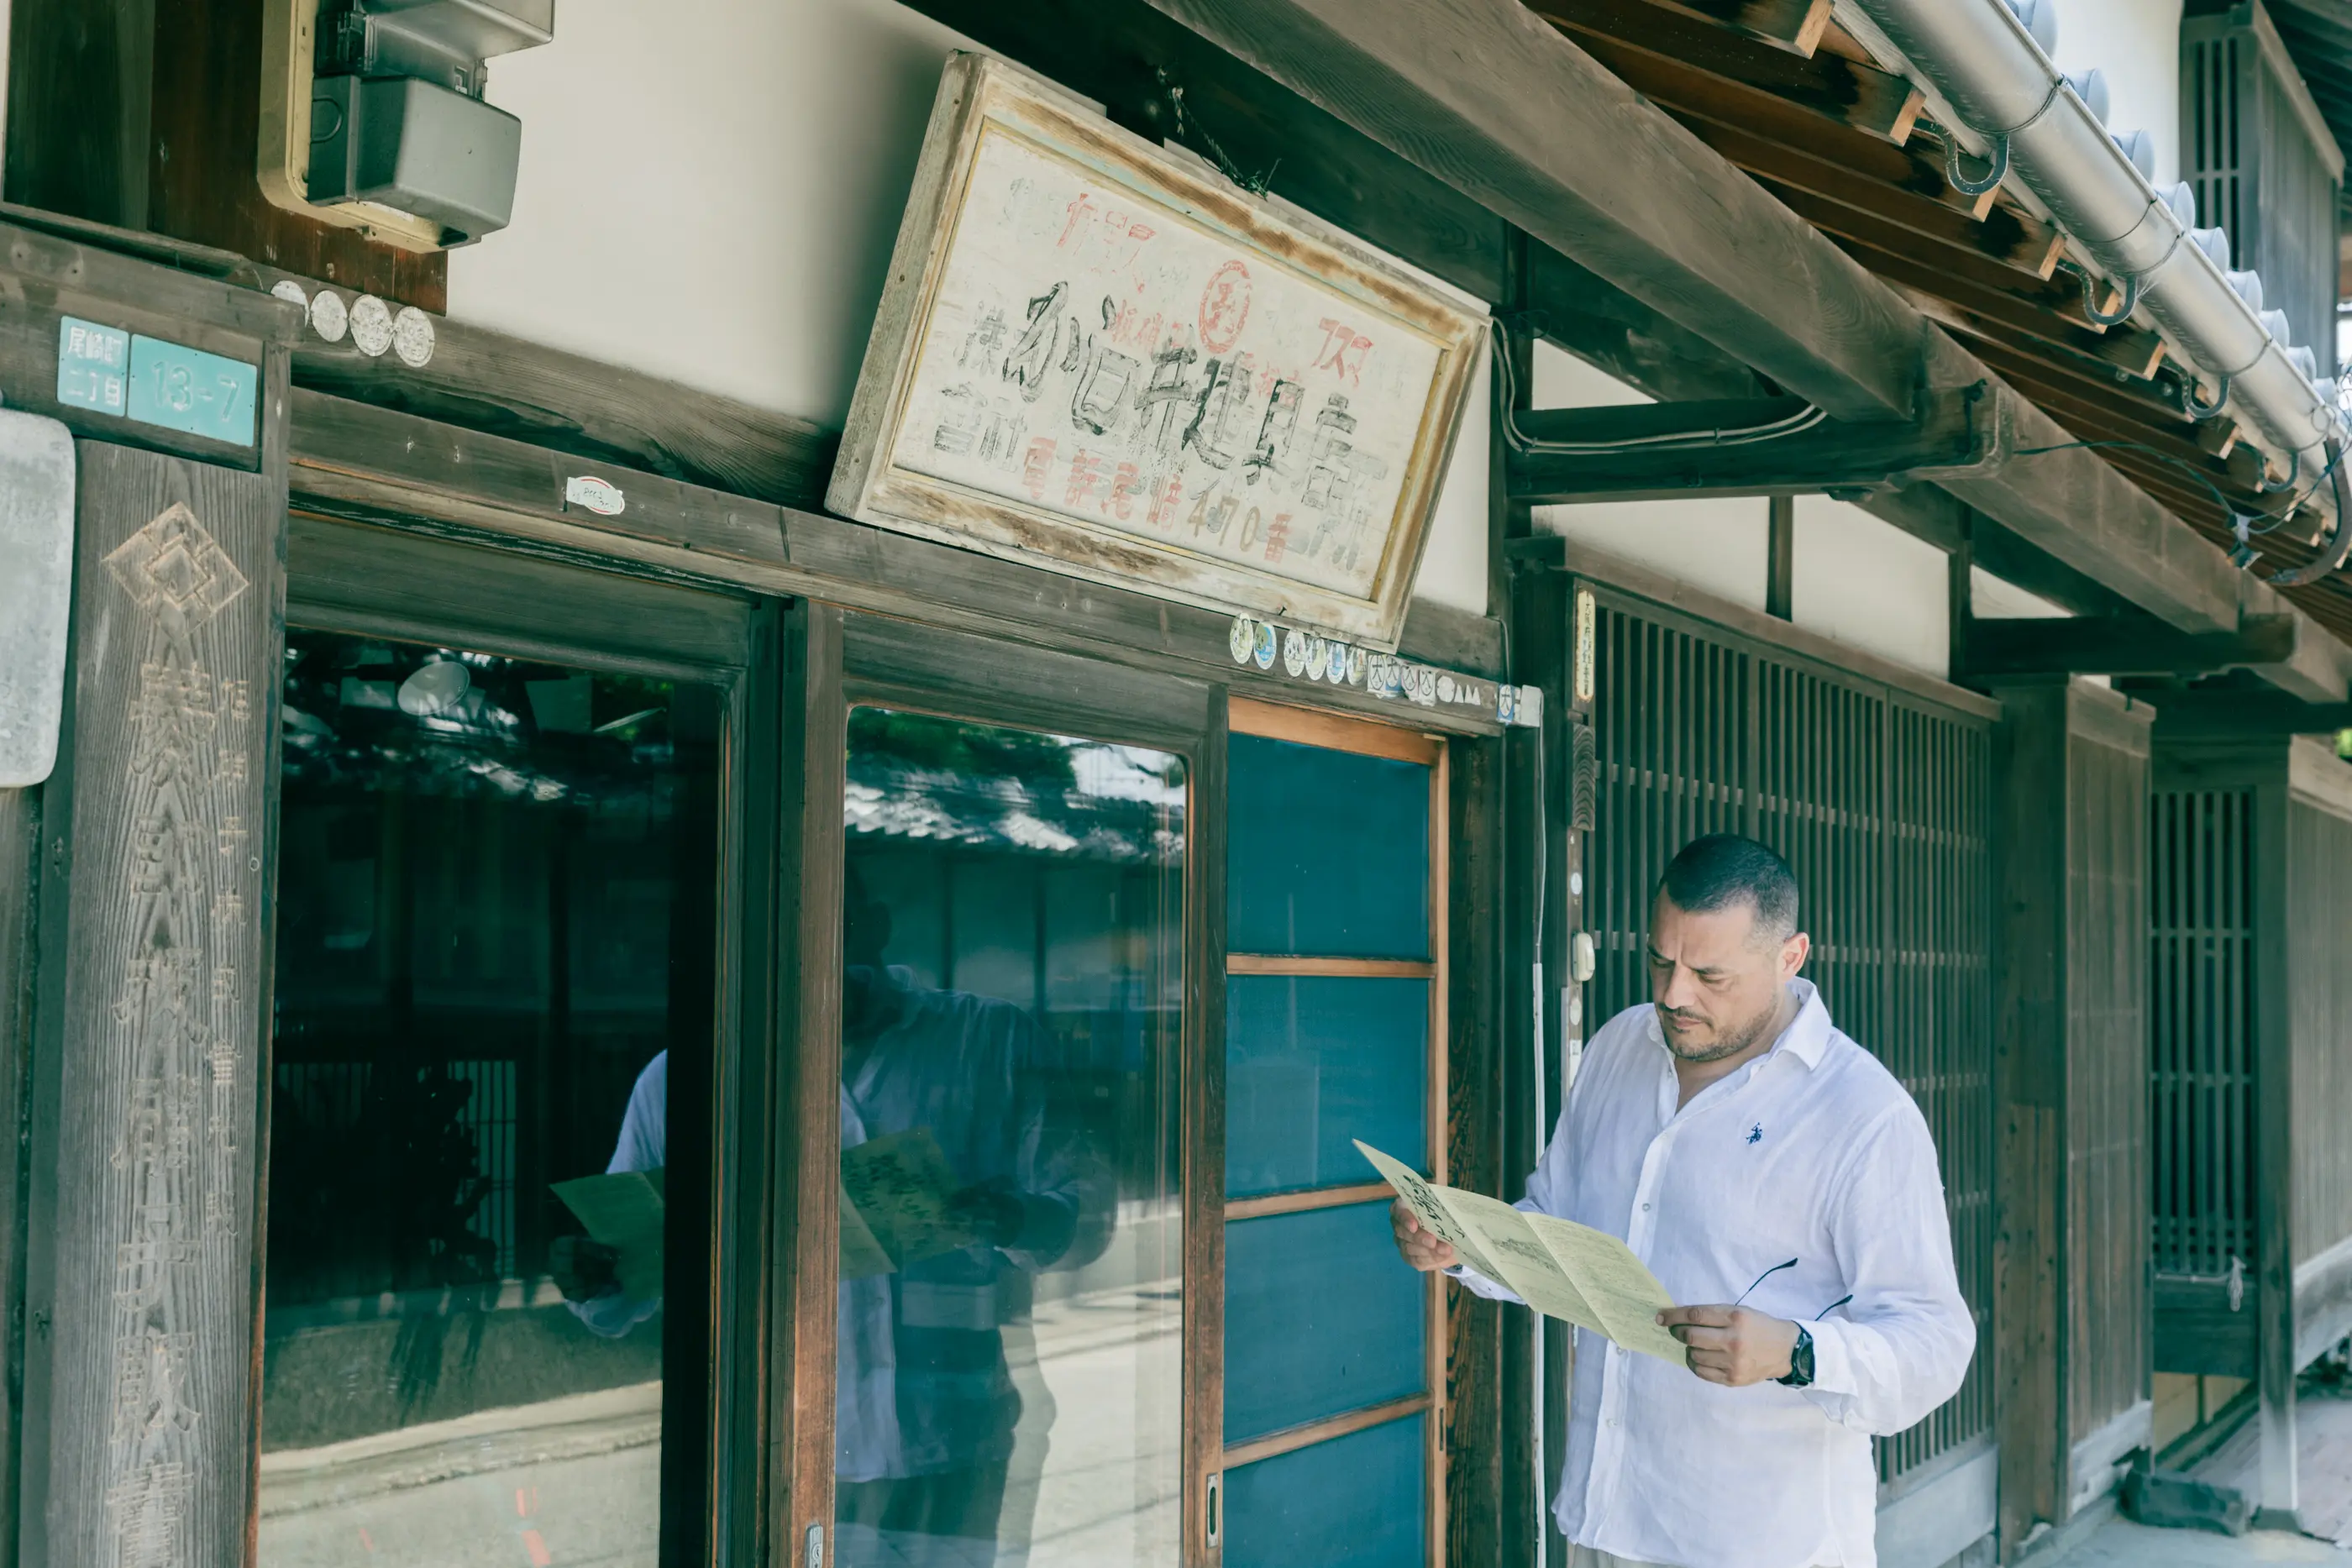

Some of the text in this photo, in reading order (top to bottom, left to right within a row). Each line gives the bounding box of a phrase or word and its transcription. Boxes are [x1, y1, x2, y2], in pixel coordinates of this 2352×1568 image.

[1312, 317, 1373, 389] フスマ
[66, 370, 122, 407] 二丁目
[151, 359, 241, 422] 13-7
